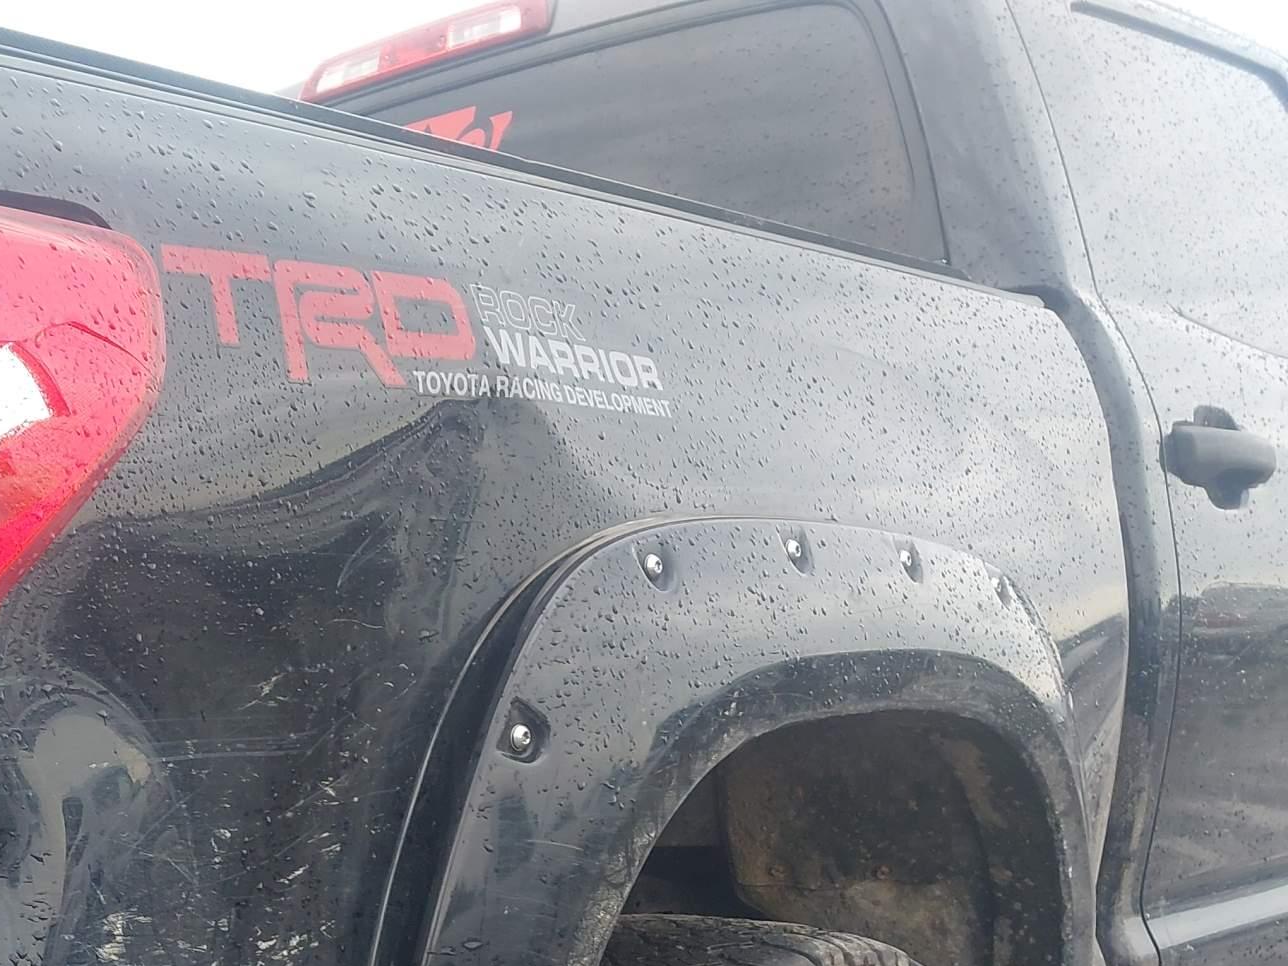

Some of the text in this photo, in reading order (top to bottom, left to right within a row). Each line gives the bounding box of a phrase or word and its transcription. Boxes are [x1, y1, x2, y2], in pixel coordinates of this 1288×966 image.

[161, 244, 476, 389] TRD
[471, 283, 586, 342] ROCK
[483, 326, 664, 391] WARRIOR
[413, 370, 673, 418] TOYOTA RACING DEVELOPMENT
